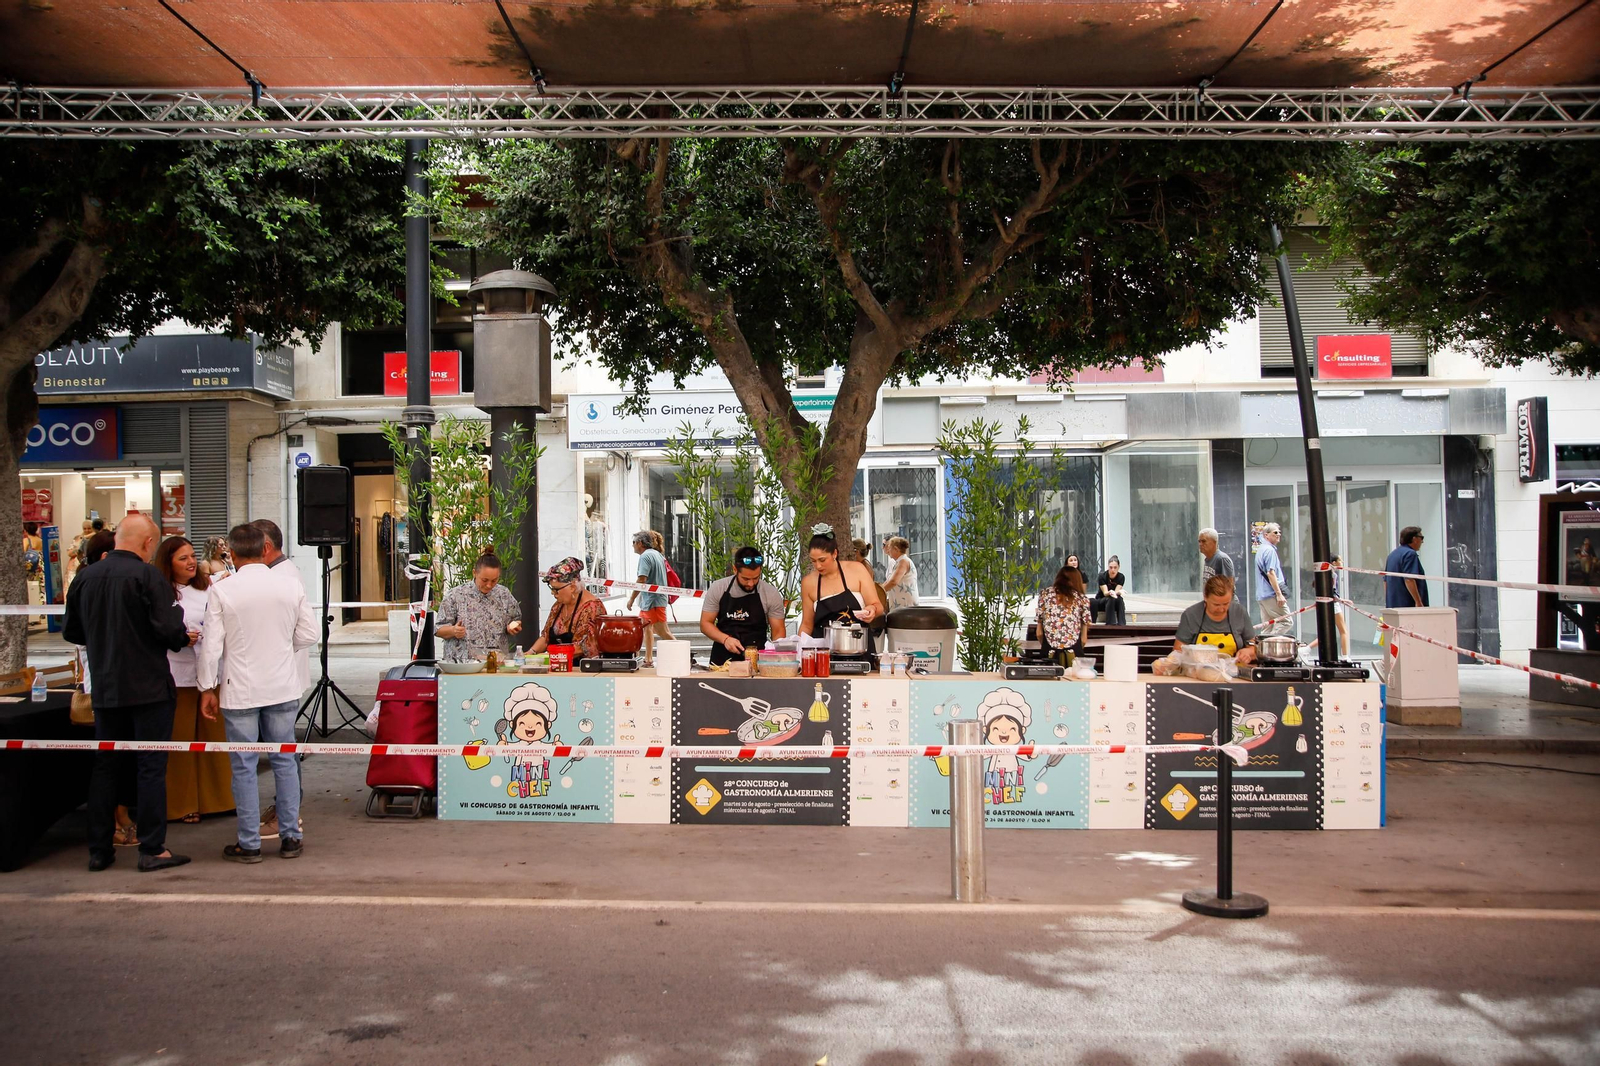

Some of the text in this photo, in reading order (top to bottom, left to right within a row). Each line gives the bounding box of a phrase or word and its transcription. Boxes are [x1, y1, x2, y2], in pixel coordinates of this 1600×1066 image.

[1323, 350, 1381, 362] Consulting
[43, 377, 106, 387] Bienestar
[661, 404, 714, 414] Giménez
[1518, 402, 1530, 477] PRIMOR
[736, 780, 779, 788] CONCURSO
[780, 780, 789, 788] de
[1255, 784, 1264, 792] de
[507, 780, 551, 798] CHEF
[724, 788, 834, 797] GASTRONOMÍA ALMERIENSE
[1259, 793, 1308, 801] ALMERIENSE
[774, 801, 804, 809] preselección
